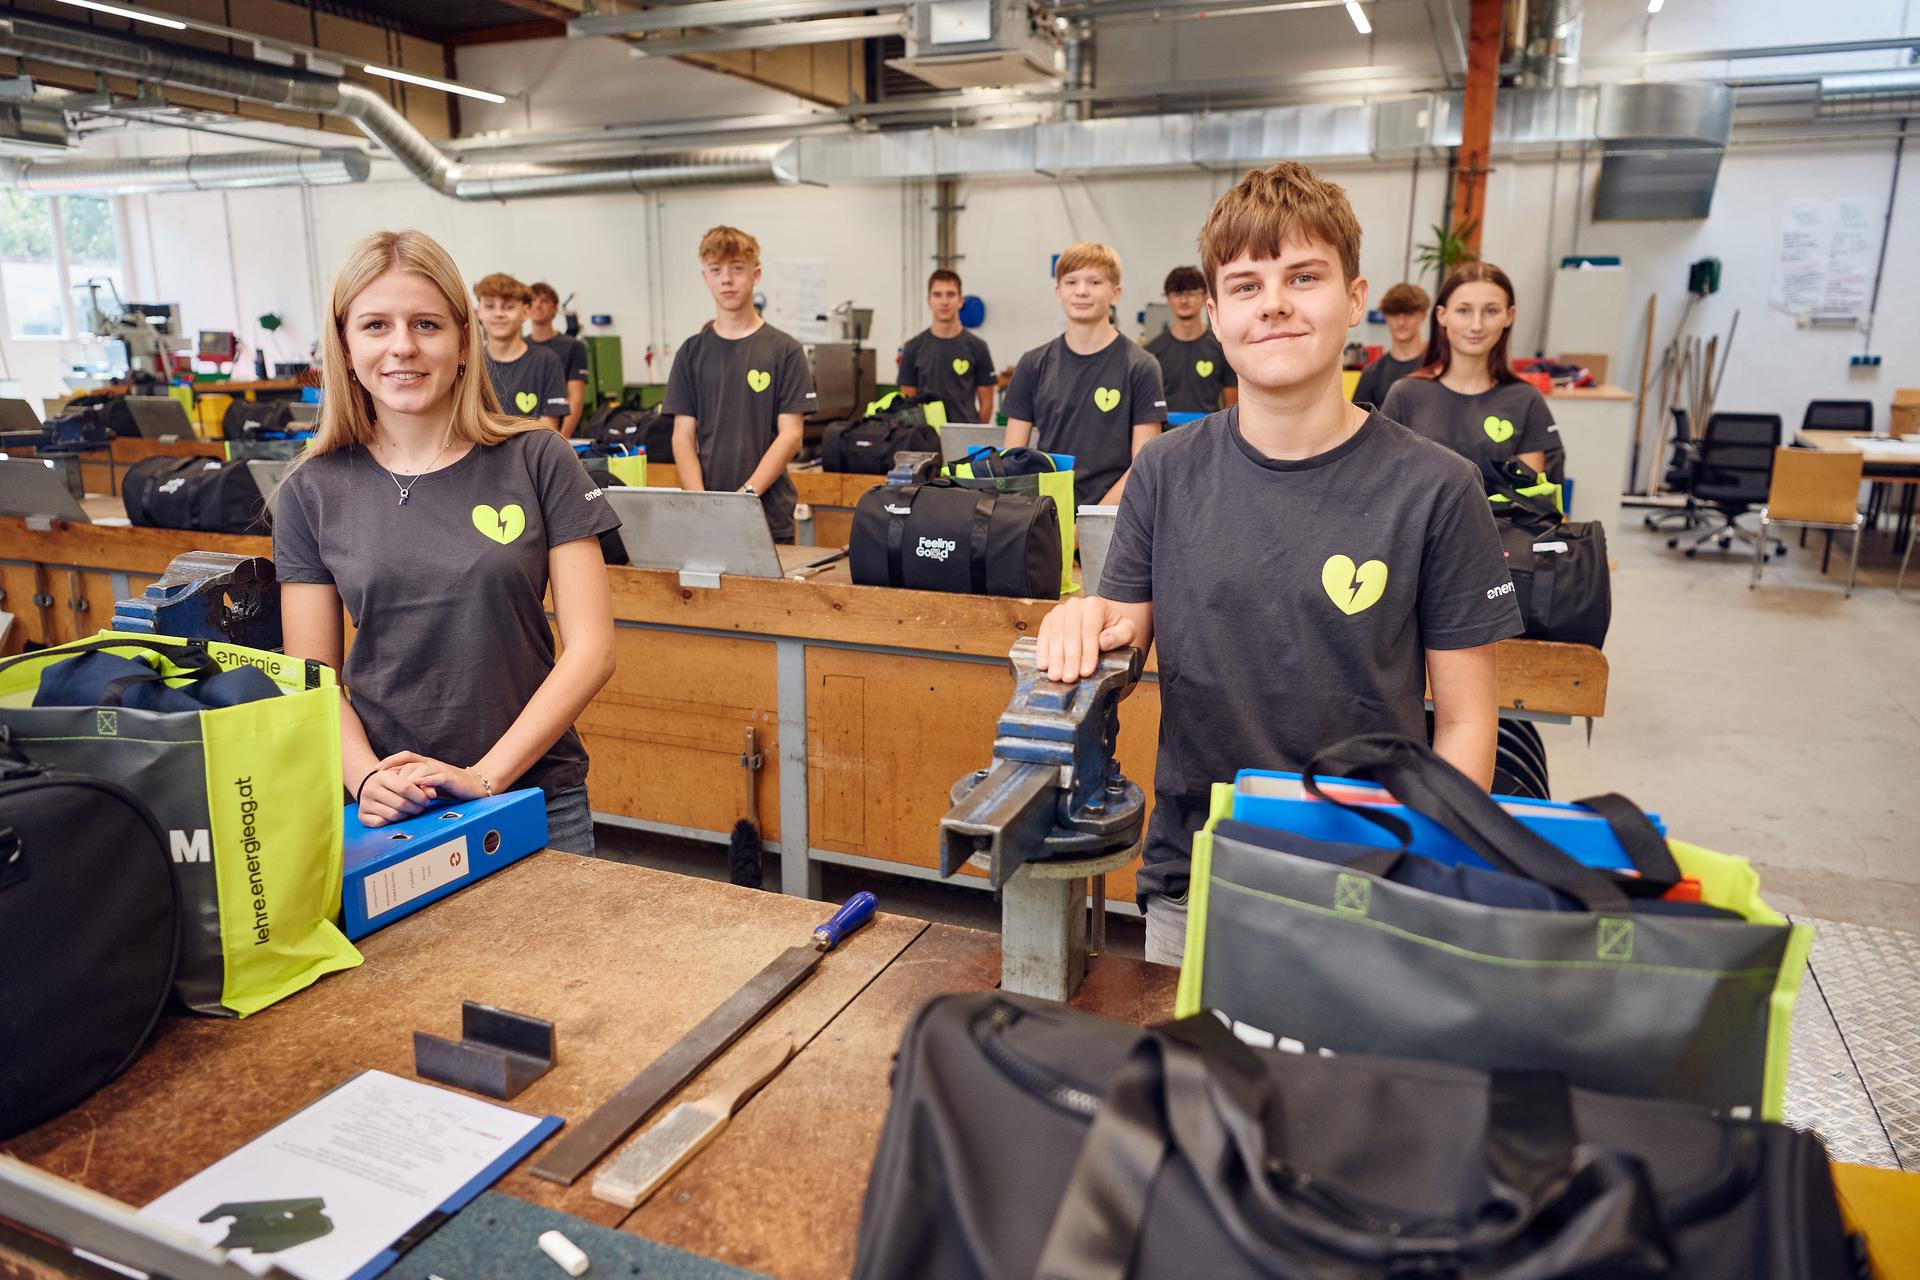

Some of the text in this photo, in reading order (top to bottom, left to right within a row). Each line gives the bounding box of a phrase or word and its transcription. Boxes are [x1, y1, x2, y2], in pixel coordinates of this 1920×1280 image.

[919, 537, 956, 551] Feeling
[216, 651, 281, 675] energie
[235, 776, 270, 945] lehre.energieag.at
